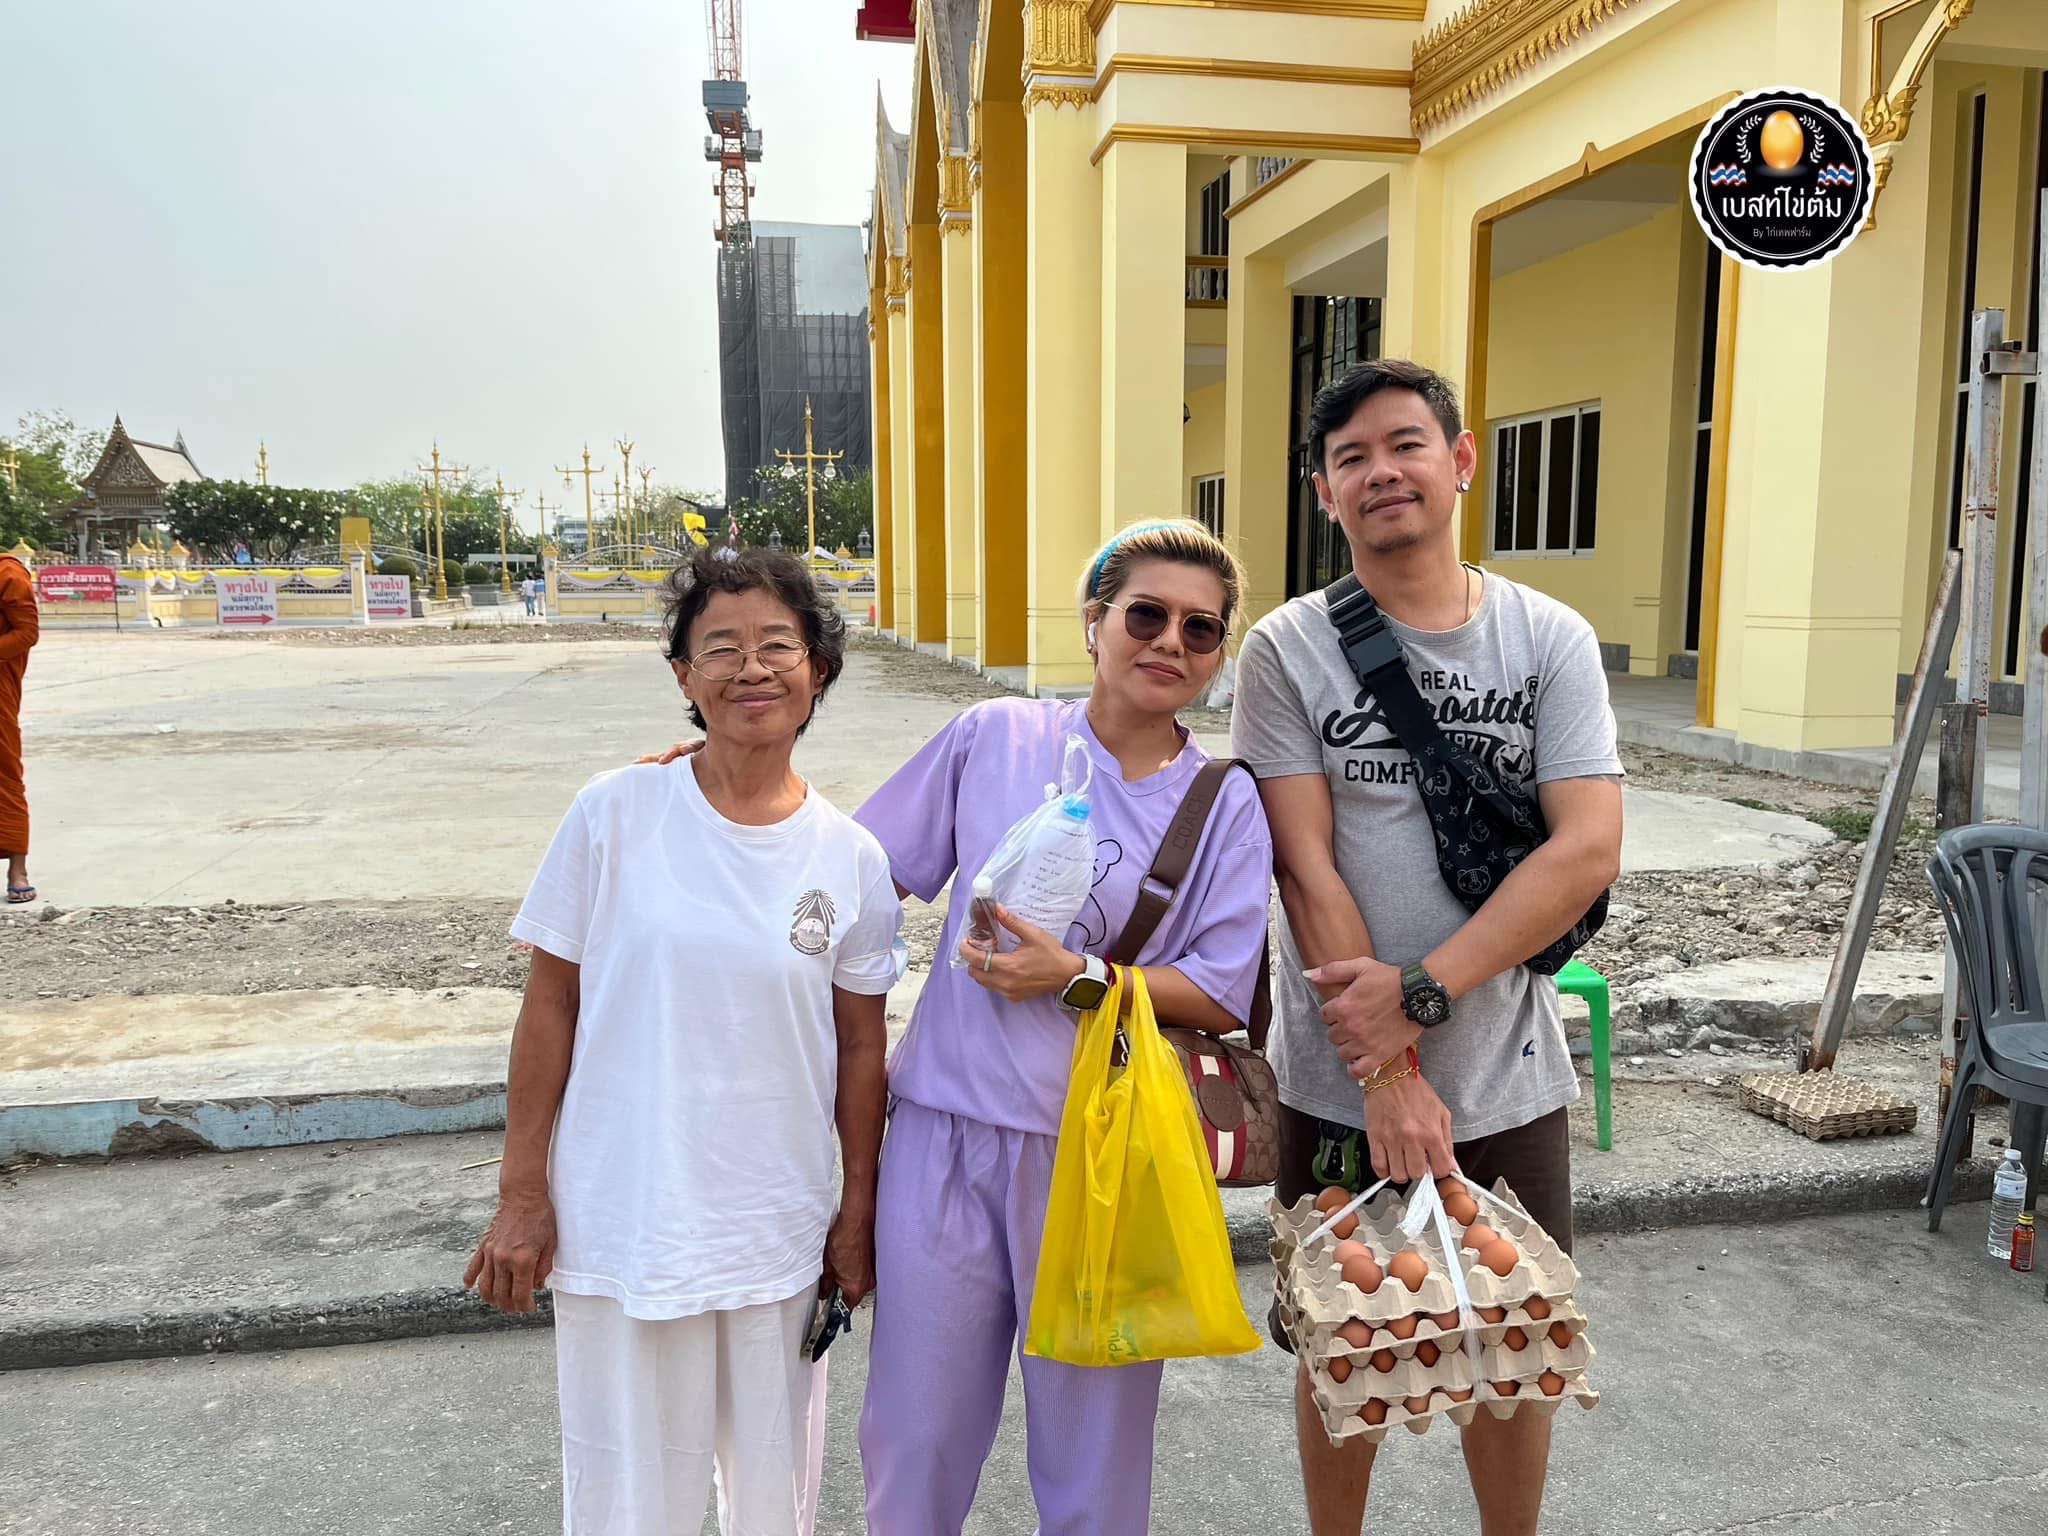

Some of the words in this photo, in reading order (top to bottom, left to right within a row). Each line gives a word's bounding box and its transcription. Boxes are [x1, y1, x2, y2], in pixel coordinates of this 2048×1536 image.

[225, 577, 269, 593] ทางไป
[369, 577, 404, 590] ทางไป
[1421, 670, 1476, 692] REAL
[1344, 759, 1414, 785] COMP
